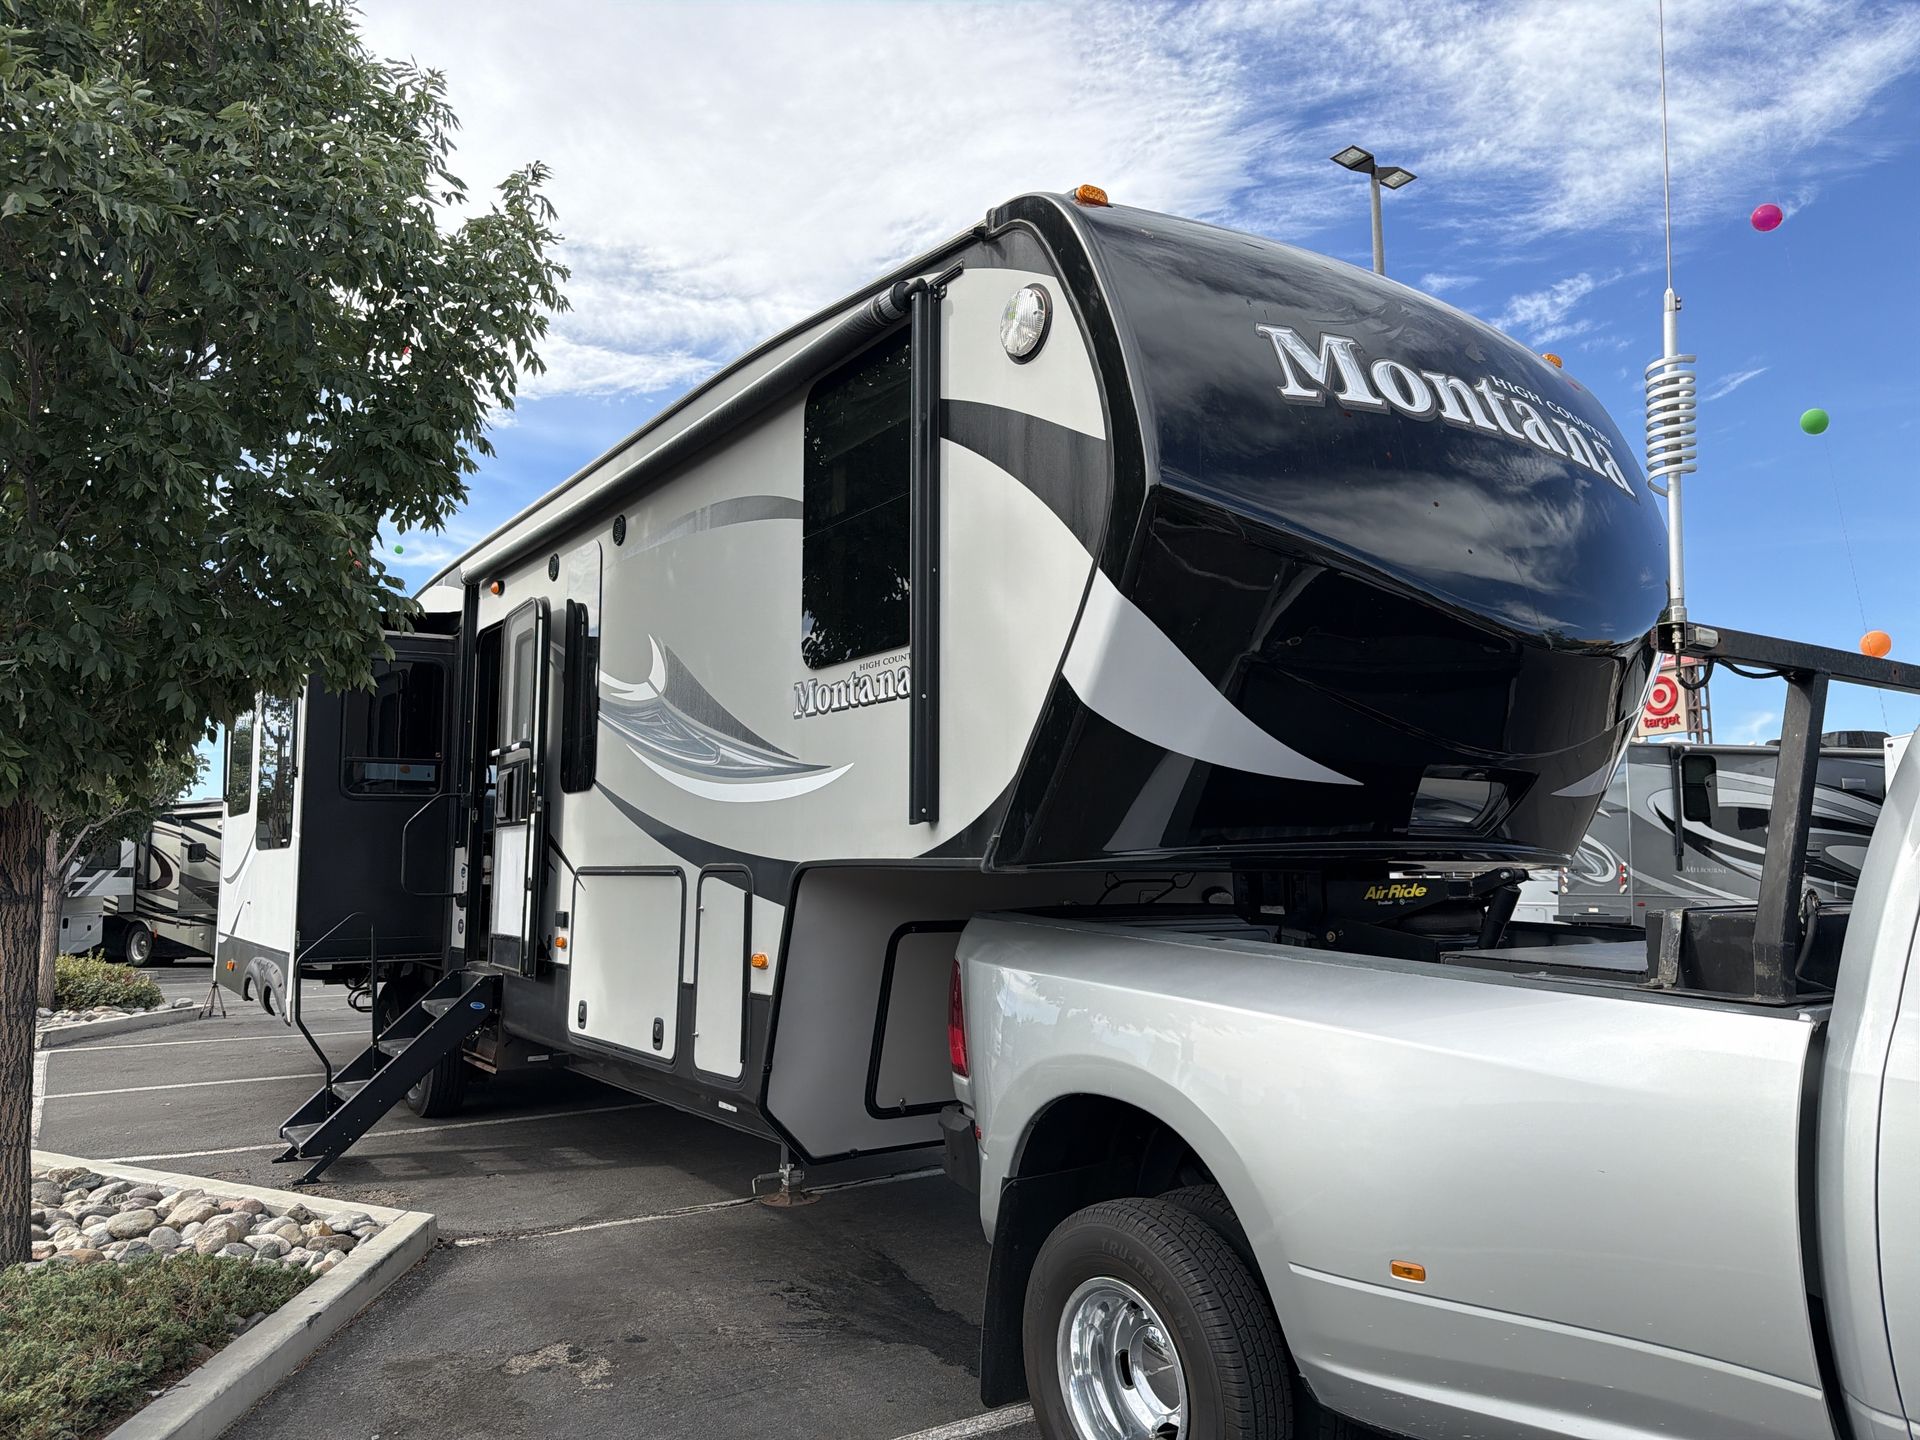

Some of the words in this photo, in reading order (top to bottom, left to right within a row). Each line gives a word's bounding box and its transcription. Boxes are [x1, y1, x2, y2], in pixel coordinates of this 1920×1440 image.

[1255, 323, 1638, 501] Montana
[1489, 374, 1544, 406] HIGH
[1545, 400, 1613, 449] COUNTRY
[794, 665, 911, 719] Montana
[859, 659, 881, 671] HIGH
[1643, 714, 1681, 728] target
